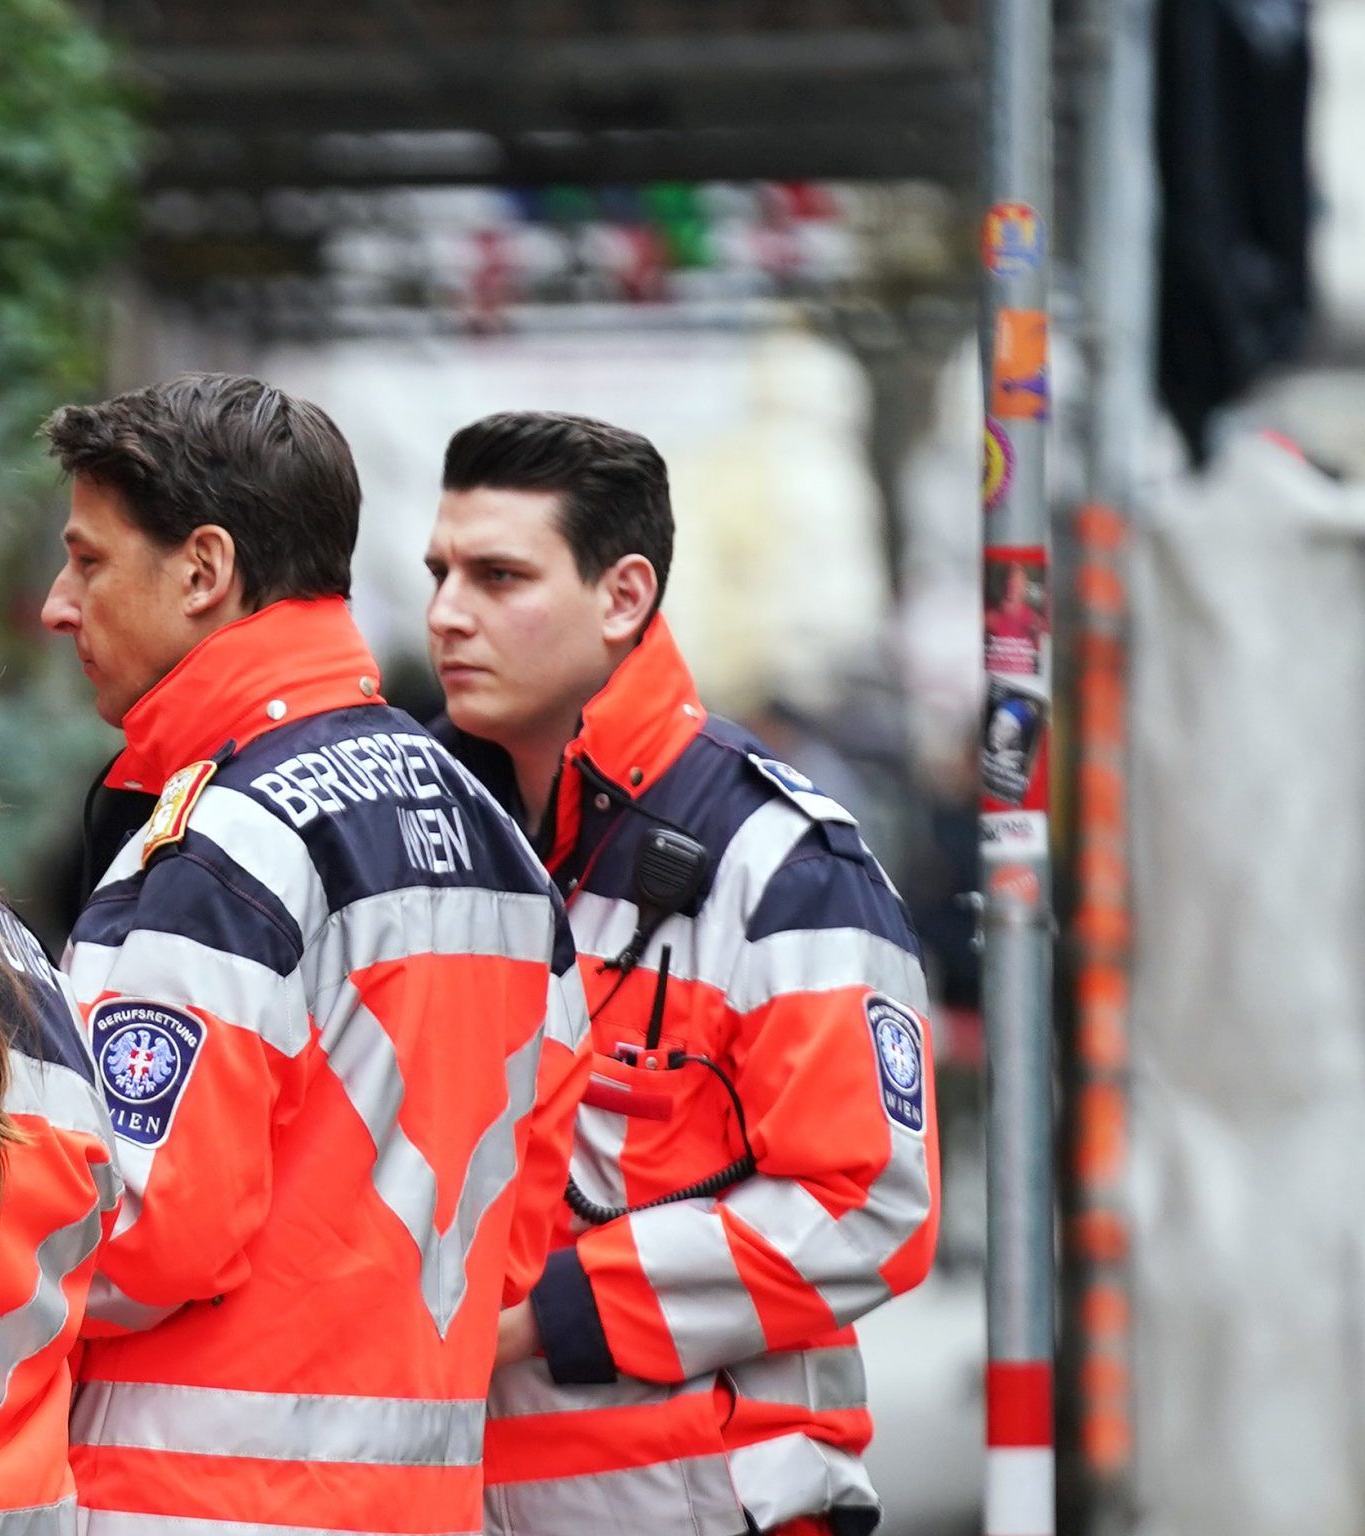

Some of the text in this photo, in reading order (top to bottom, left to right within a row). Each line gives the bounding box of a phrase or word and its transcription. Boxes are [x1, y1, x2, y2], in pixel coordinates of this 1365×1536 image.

[96, 1008, 198, 1048] BERUFSRETTUNG
[109, 1107, 161, 1135] IEN
[885, 1088, 922, 1125] WIEN
